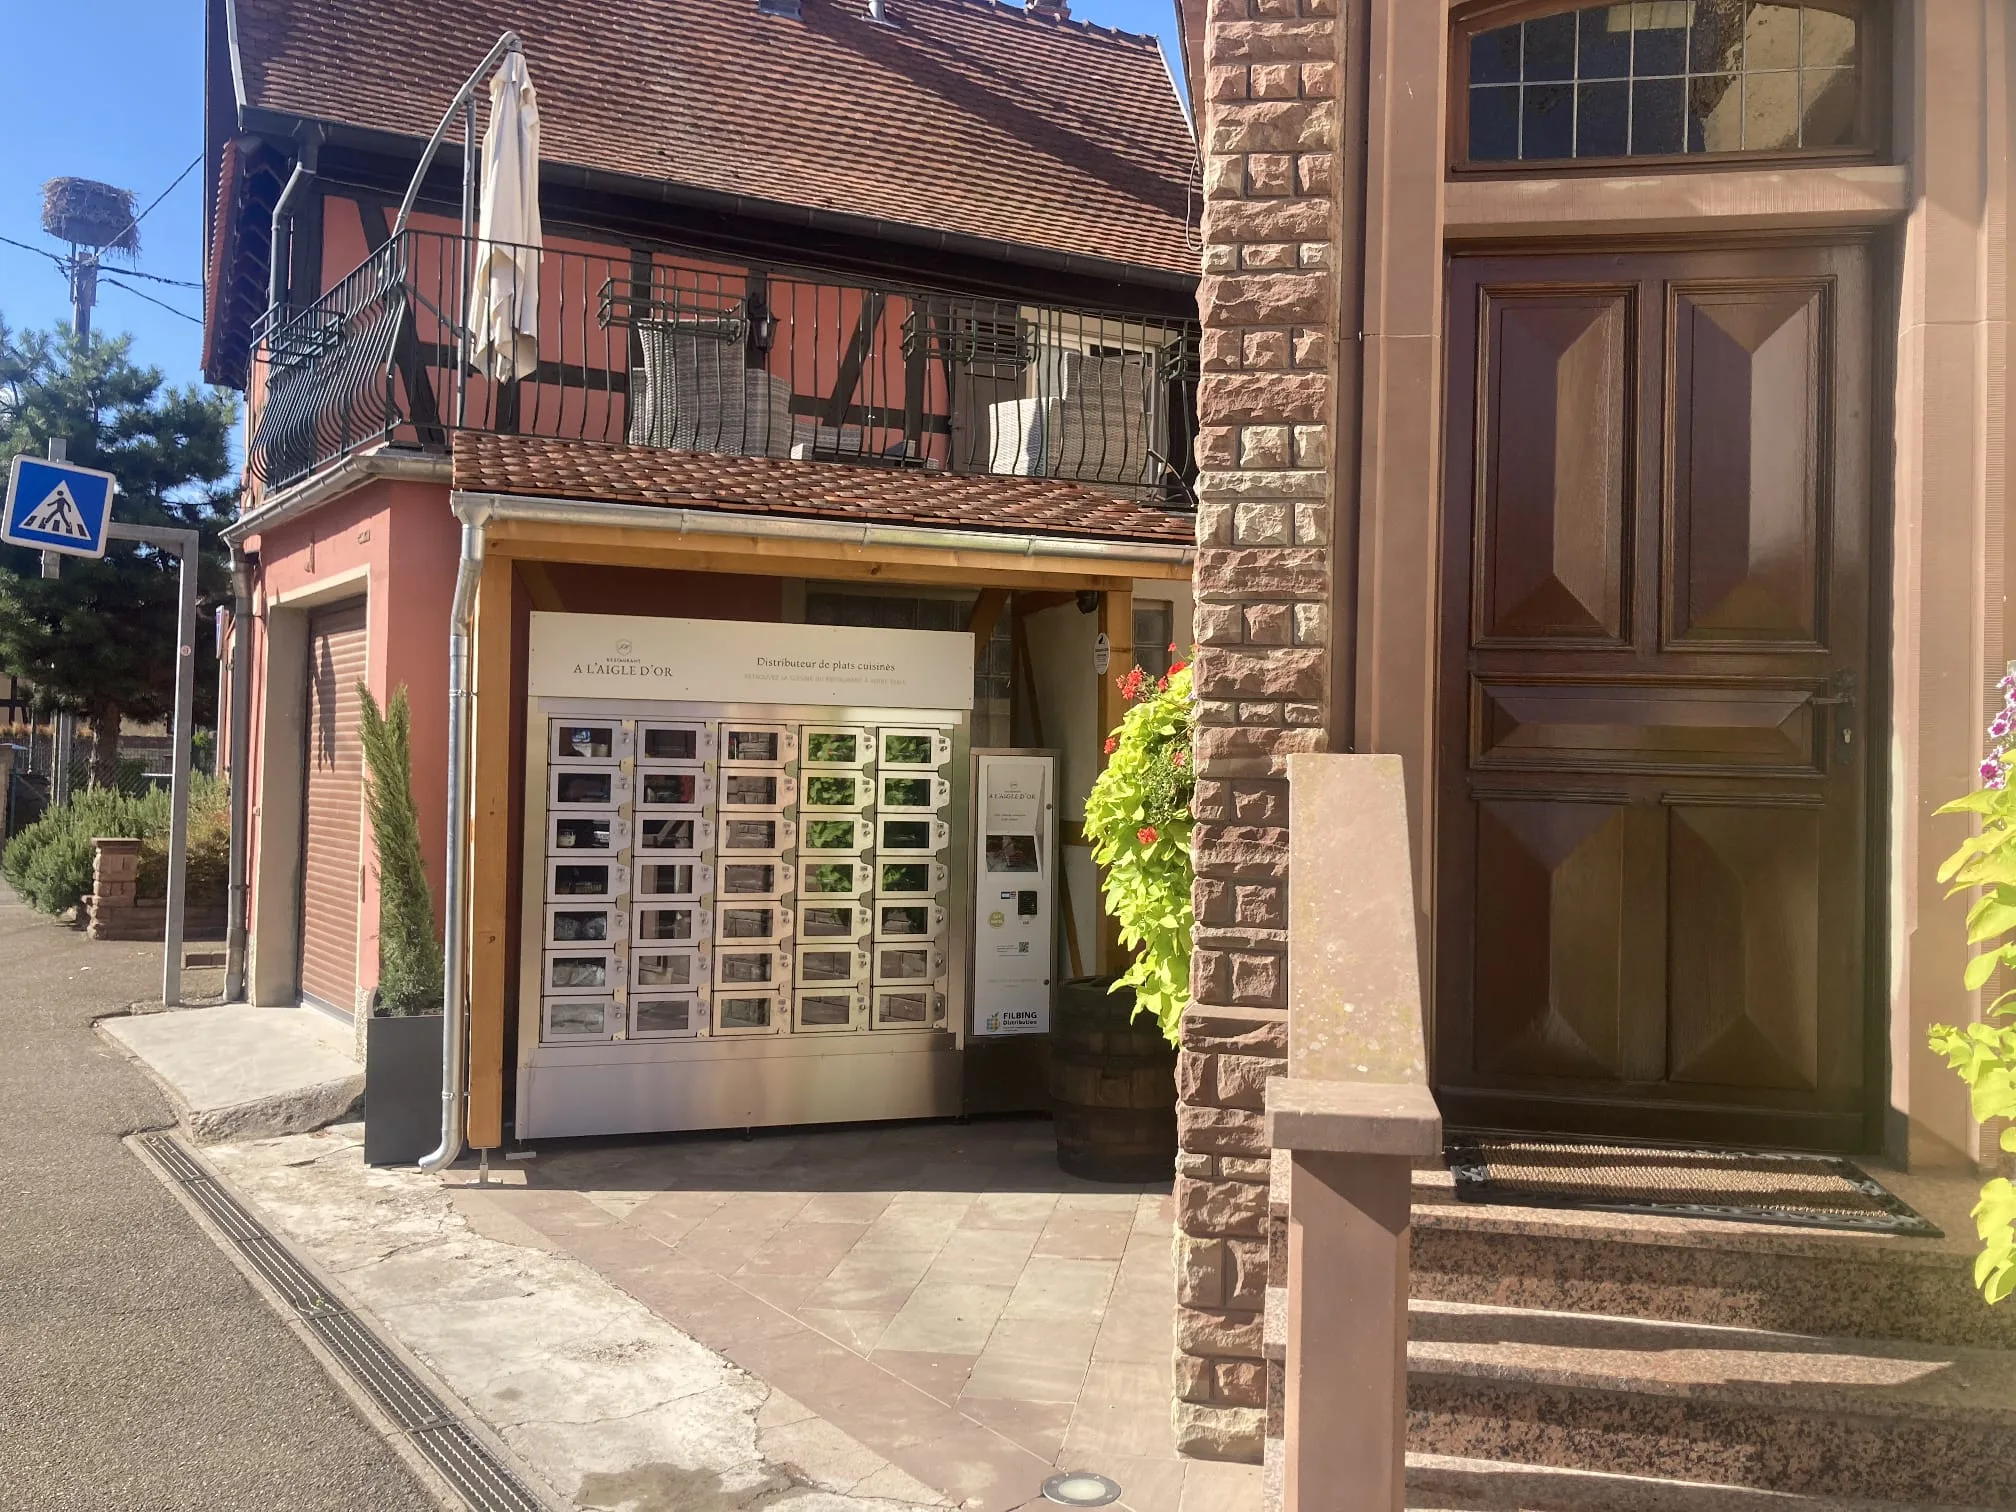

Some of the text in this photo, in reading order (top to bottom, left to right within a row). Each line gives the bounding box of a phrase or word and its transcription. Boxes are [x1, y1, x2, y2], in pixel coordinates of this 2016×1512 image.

[573, 662, 673, 677] A L'AIGLE D'OR
[757, 657, 817, 669] Distributeur
[818, 659, 830, 669] de
[832, 660, 856, 672] plats
[1003, 1011, 1038, 1020] FILBING
